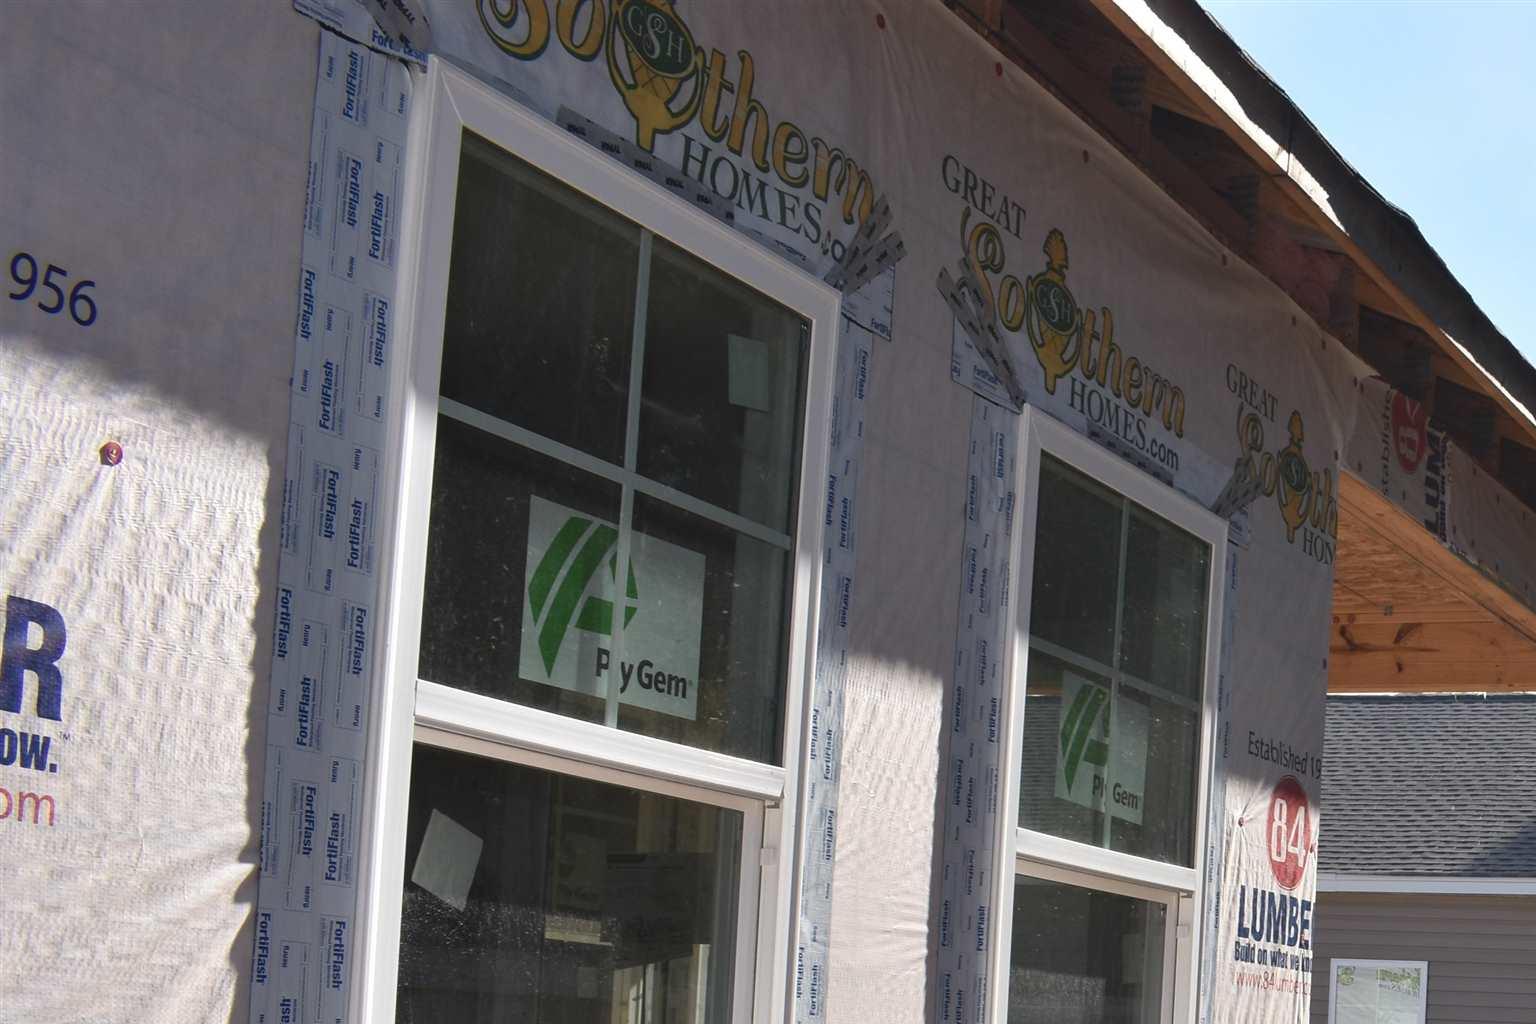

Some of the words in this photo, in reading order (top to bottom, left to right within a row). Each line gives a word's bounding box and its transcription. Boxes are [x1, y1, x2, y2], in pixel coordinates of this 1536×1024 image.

[343, 51, 360, 119] FortiFlash
[347, 159, 362, 227] FortiFlash
[369, 190, 384, 259] FortiFlash
[680, 132, 846, 264] HOMES.co
[942, 155, 1027, 240] GREAT
[8, 252, 97, 327] 956
[300, 269, 316, 340] FortiFlash
[374, 300, 388, 368] FortiFlash
[319, 360, 333, 430] FortiFlash
[1068, 375, 1180, 472] HOMES.com
[1226, 363, 1278, 423] GREAT
[324, 470, 339, 539] FortiFlash
[348, 498, 362, 568] FortiFlash
[278, 589, 292, 658] FortiFlash
[352, 608, 367, 675] FortiFlash
[0, 595, 67, 722] R
[596, 647, 634, 694] Py
[636, 660, 688, 699] Gem
[297, 676, 311, 746] FortiFlash
[1248, 731, 1308, 775] Established
[302, 786, 316, 855] FortiFlash
[1113, 782, 1138, 810] Gem
[325, 812, 340, 881] FortiFlash
[1271, 798, 1306, 868] 84
[256, 913, 271, 984] FortiFlash
[1237, 885, 1311, 950] LUMBE
[332, 921, 346, 989] FortiFlash
[1257, 948, 1268, 965] on
